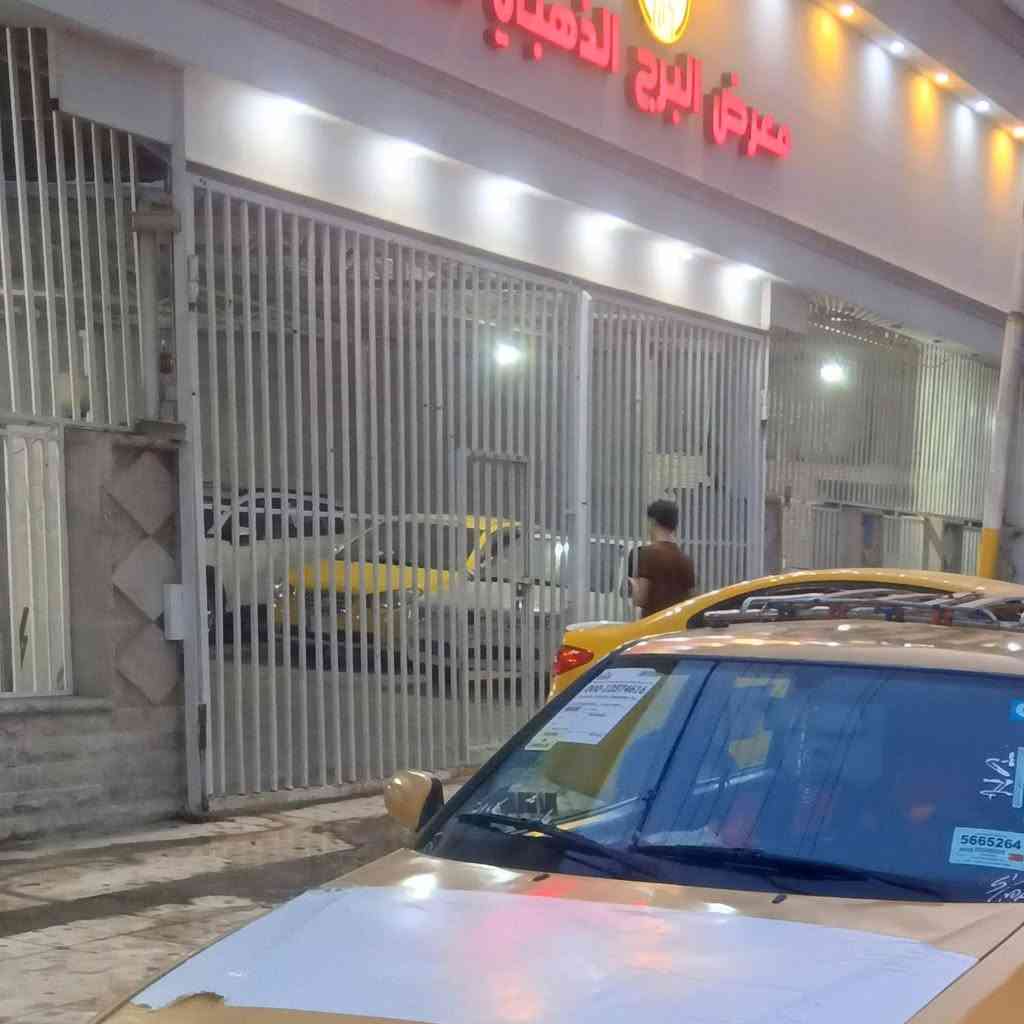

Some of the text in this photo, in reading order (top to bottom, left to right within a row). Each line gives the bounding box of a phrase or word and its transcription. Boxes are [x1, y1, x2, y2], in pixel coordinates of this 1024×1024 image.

[633, 47, 704, 124] البرج
[710, 72, 792, 159] معرض
[960, 834, 1022, 850] 5665264
